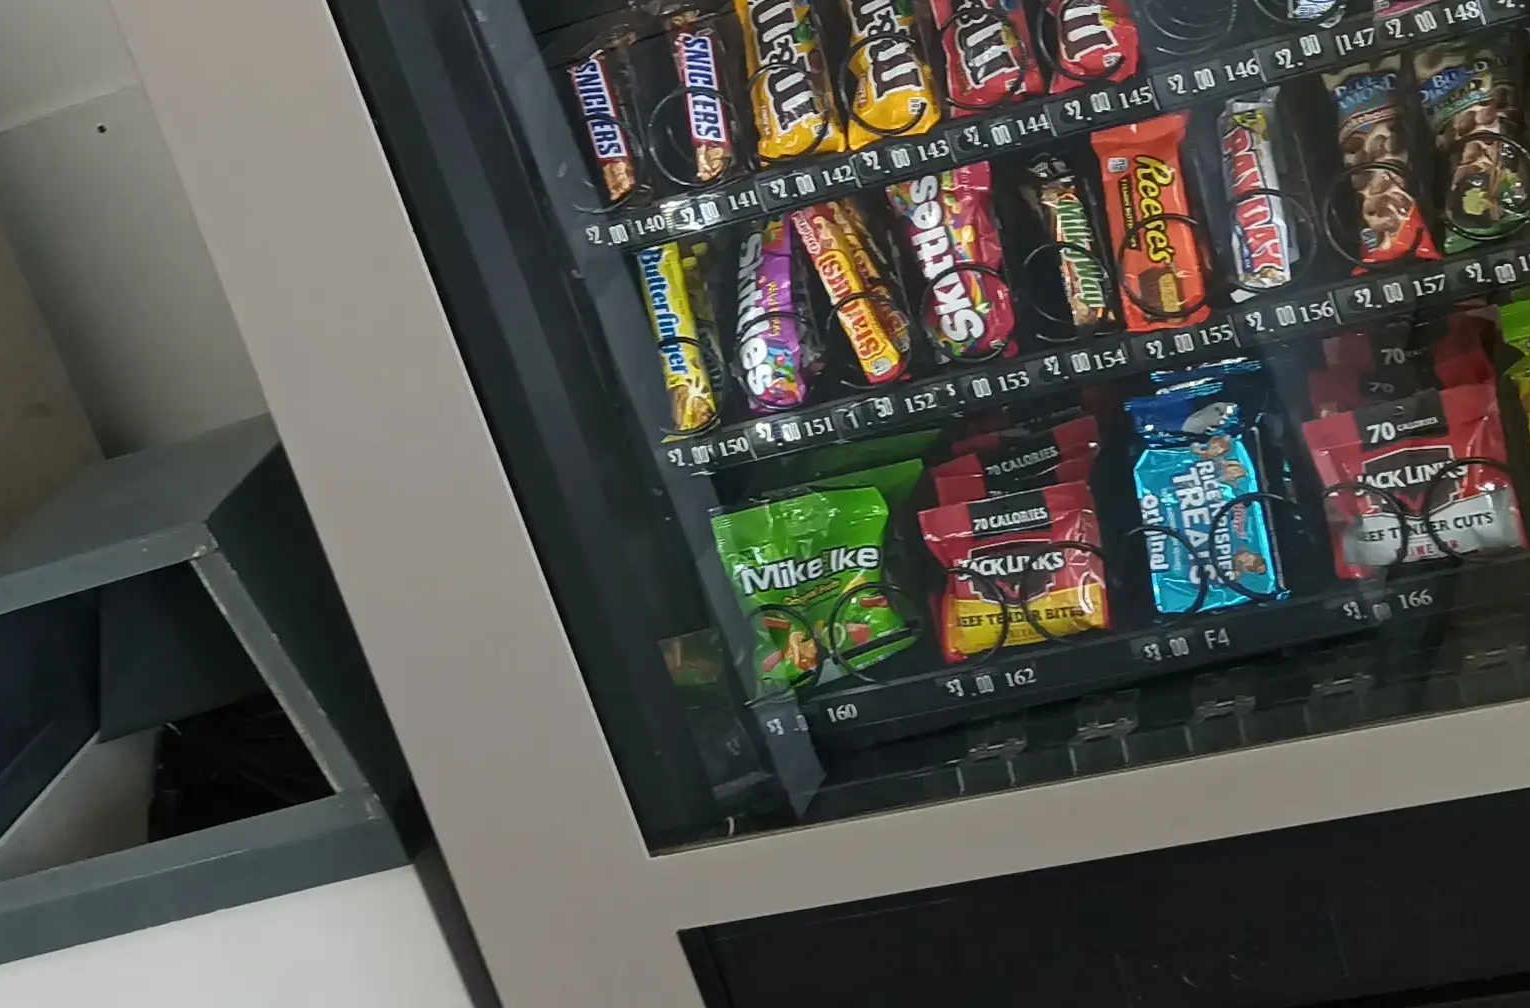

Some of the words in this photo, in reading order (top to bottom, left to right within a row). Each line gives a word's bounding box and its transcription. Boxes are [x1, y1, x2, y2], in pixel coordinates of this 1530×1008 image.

[1444, 0, 1479, 24] 148
[1345, 28, 1376, 53] 147
[1224, 58, 1259, 82] 146
[575, 60, 622, 157] SNICKERS
[1118, 85, 1153, 109] 145
[1016, 113, 1050, 136] 144
[917, 140, 950, 162] 143
[821, 165, 854, 187] 142
[727, 191, 759, 212] 141
[1132, 154, 1174, 265] Reese's
[634, 214, 665, 237] 140
[909, 174, 986, 343] Skittles
[1412, 274, 1445, 297] 157
[1299, 299, 1334, 322] 156
[1199, 323, 1233, 346] 155
[1093, 348, 1127, 370] 154
[997, 371, 1029, 392] 153
[904, 393, 937, 412] 152
[803, 416, 834, 437] 151
[1368, 424, 1396, 443] 70
[718, 437, 749, 458] 150
[988, 506, 1049, 527] CALORIES
[1388, 517, 1450, 539] TNDER
[1453, 511, 1495, 531] CUTS
[740, 554, 824, 596] Mike
[829, 545, 881, 573] Ike
[1397, 589, 1434, 610] 166
[1204, 628, 1231, 651] F4
[1004, 668, 1037, 688] 162
[826, 703, 858, 723] 160
